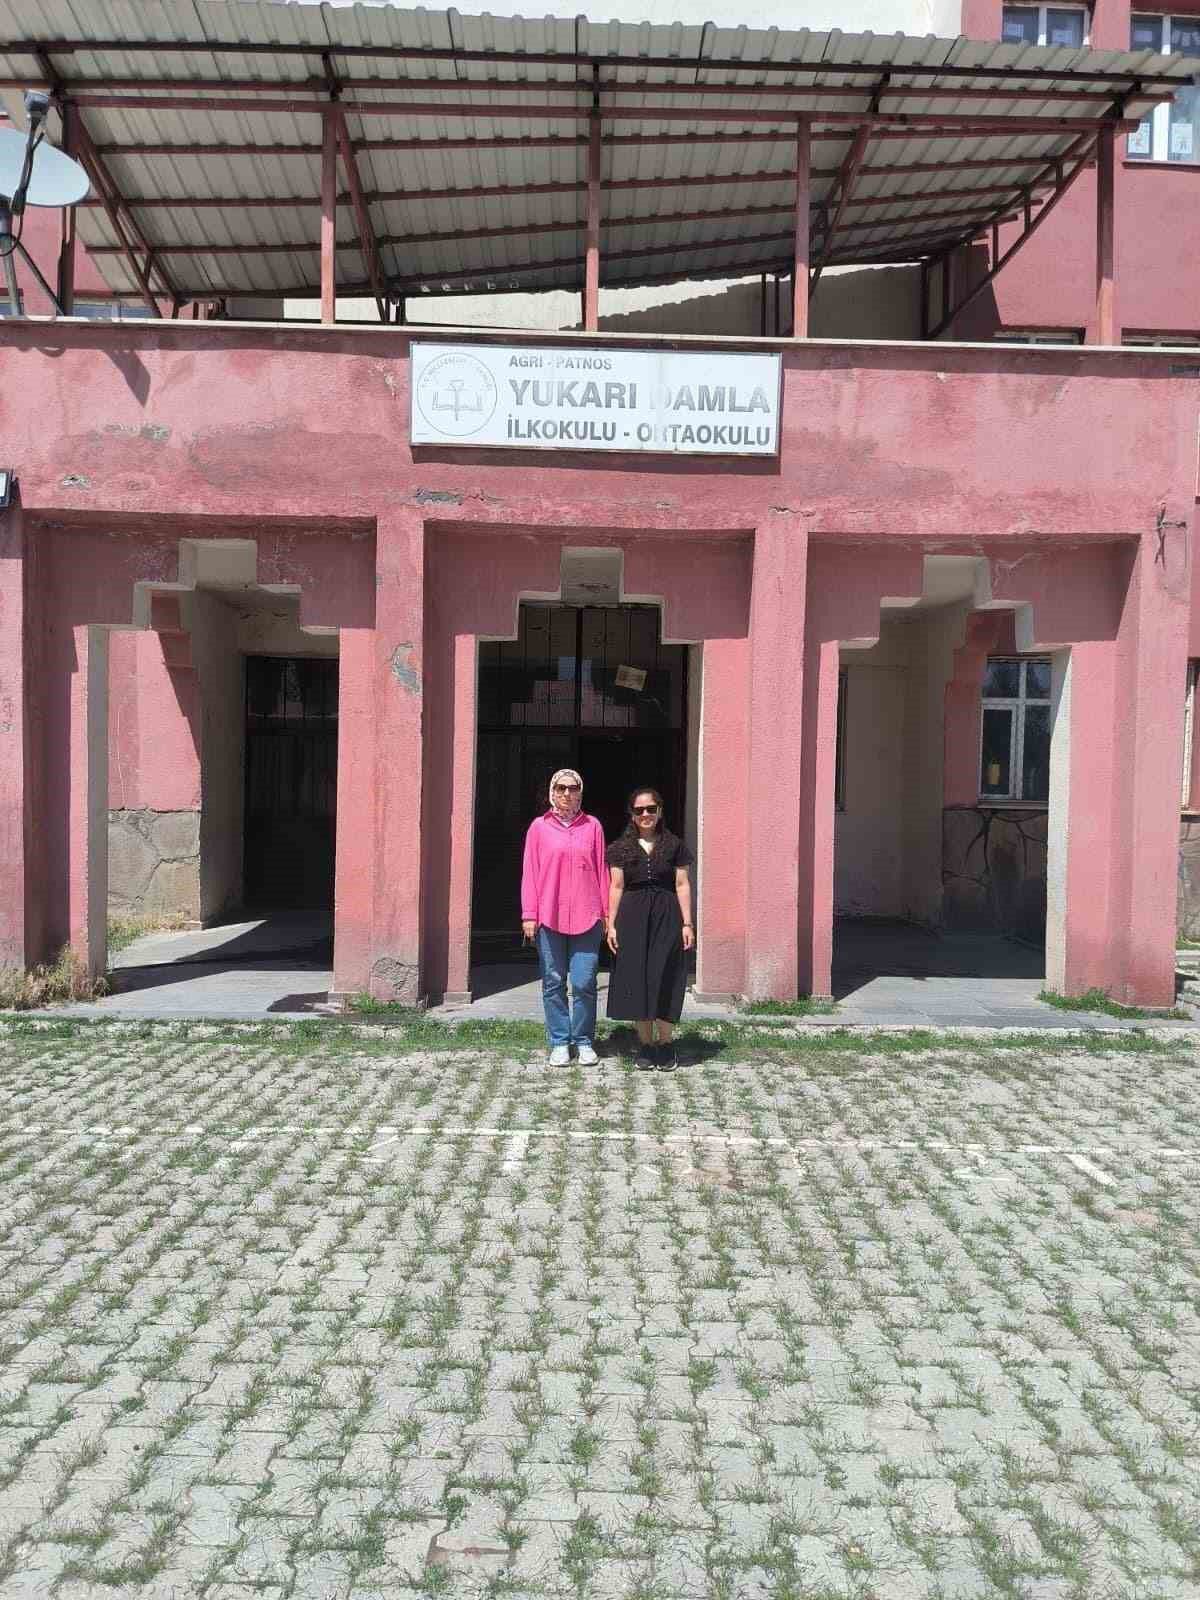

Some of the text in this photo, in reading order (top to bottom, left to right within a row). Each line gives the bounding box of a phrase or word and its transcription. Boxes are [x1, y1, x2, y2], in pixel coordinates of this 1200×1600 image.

[556, 356, 612, 370] PATNOS
[508, 379, 637, 408] YUKARI
[507, 413, 616, 440] İLKOKULU
